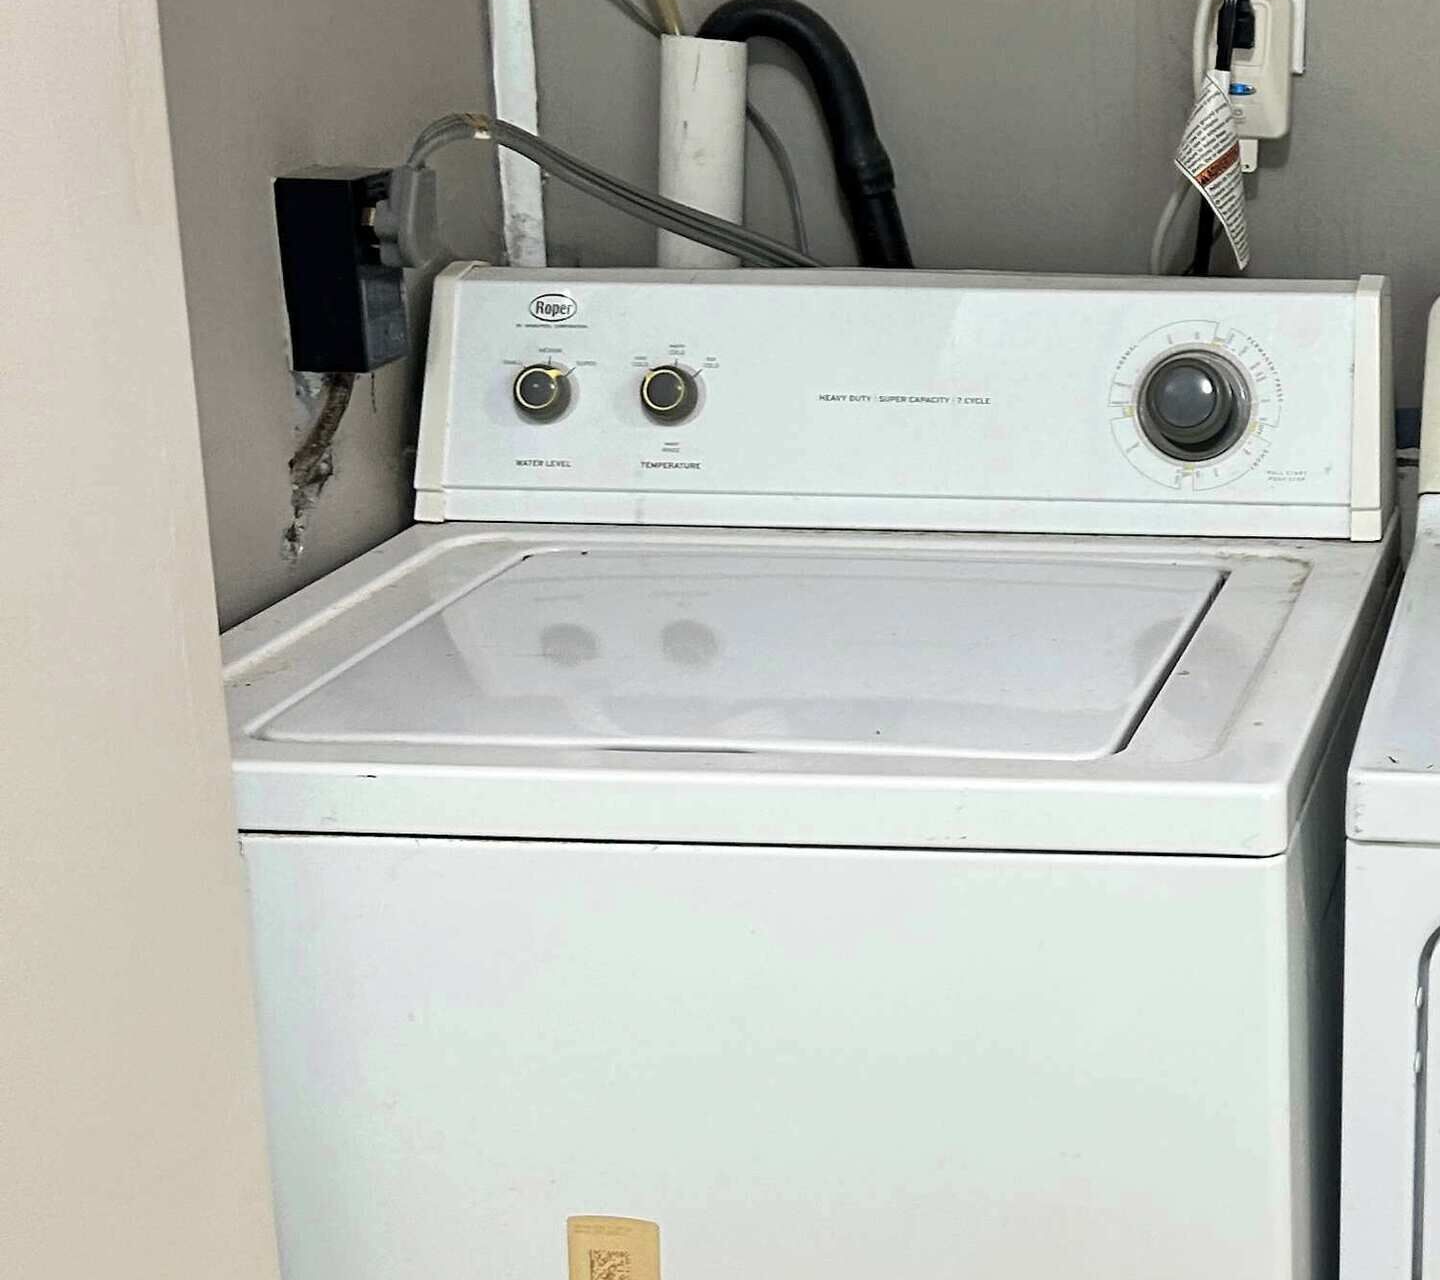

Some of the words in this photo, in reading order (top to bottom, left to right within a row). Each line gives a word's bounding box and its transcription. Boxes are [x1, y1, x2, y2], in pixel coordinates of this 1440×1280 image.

[535, 300, 574, 318] Roper
[819, 394, 847, 402] HEAVY
[848, 394, 871, 402] DUTY
[878, 395, 906, 403] SUPER
[908, 396, 950, 404] CAPACITY
[964, 397, 992, 405] CYCLE
[515, 459, 543, 467] WATER
[545, 460, 572, 468] LEVEL
[640, 460, 702, 470] TEMPERATURE
